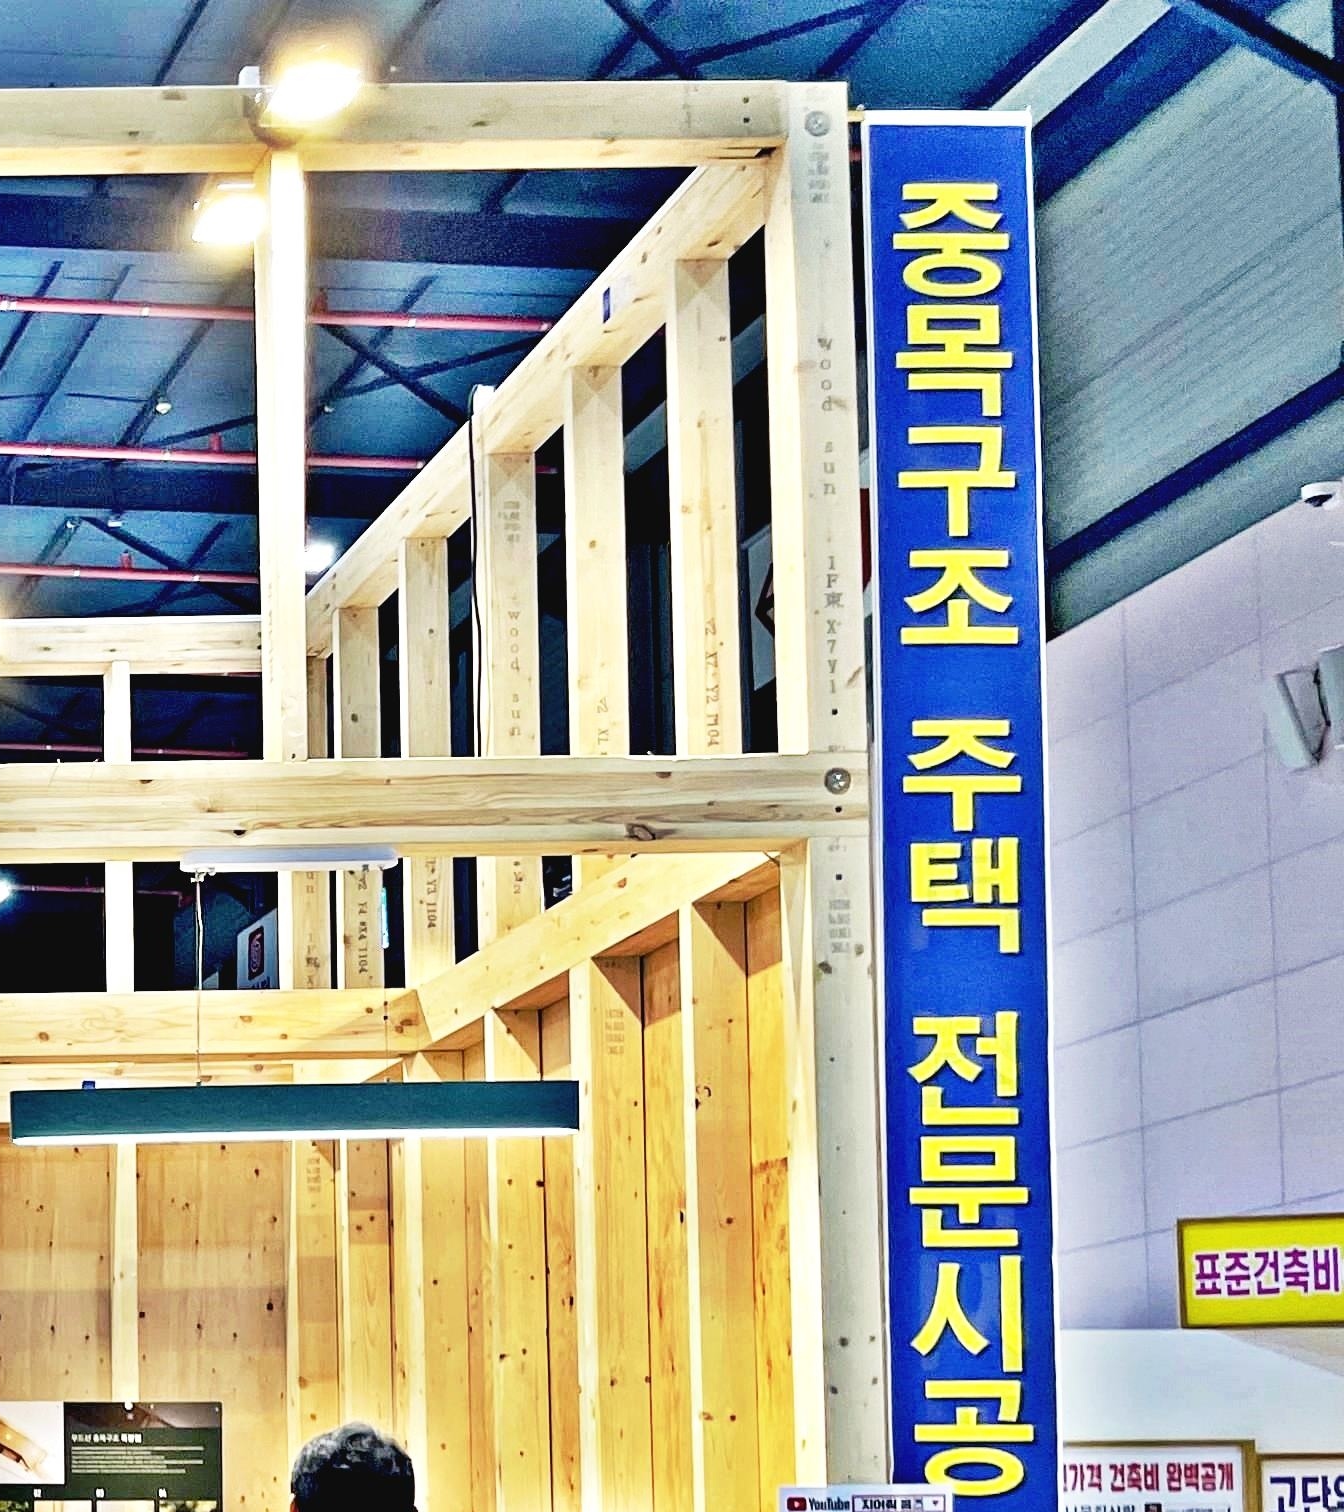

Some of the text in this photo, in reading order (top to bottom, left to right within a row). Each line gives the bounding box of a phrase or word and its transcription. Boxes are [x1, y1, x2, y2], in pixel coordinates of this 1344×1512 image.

[817, 337, 834, 412] wood
[823, 440, 836, 496] sun
[507, 611, 520, 673] wood
[892, 182, 1036, 1499] 중목구조 주택 전문시공
[1194, 1247, 1341, 1297] 표준건축비
[808, 1497, 850, 1511] YouTube
[1109, 1462, 1160, 1493] 건축비
[1166, 1462, 1234, 1493] 완벽공개
